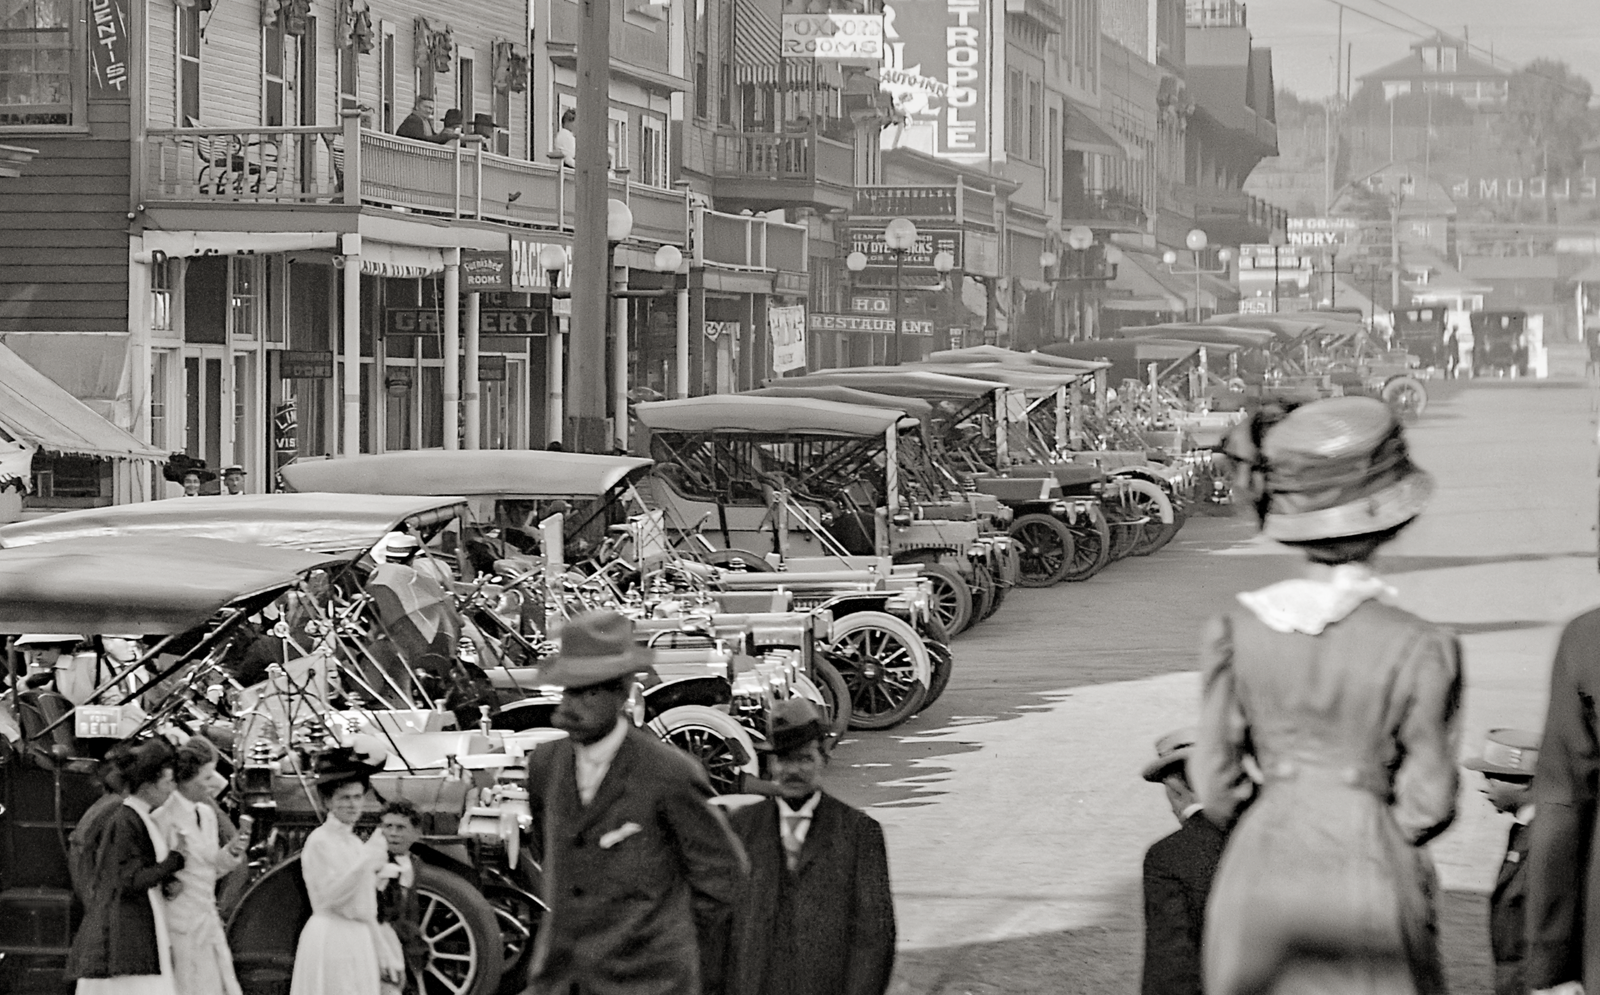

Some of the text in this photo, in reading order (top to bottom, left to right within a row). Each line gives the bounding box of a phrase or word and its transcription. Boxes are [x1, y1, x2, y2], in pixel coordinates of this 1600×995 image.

[794, 19, 880, 36] OXORD
[784, 40, 877, 53] ROOMS
[512, 240, 572, 288] PACIC
[467, 275, 502, 285] ROOMS
[395, 312, 536, 332] GRERY
